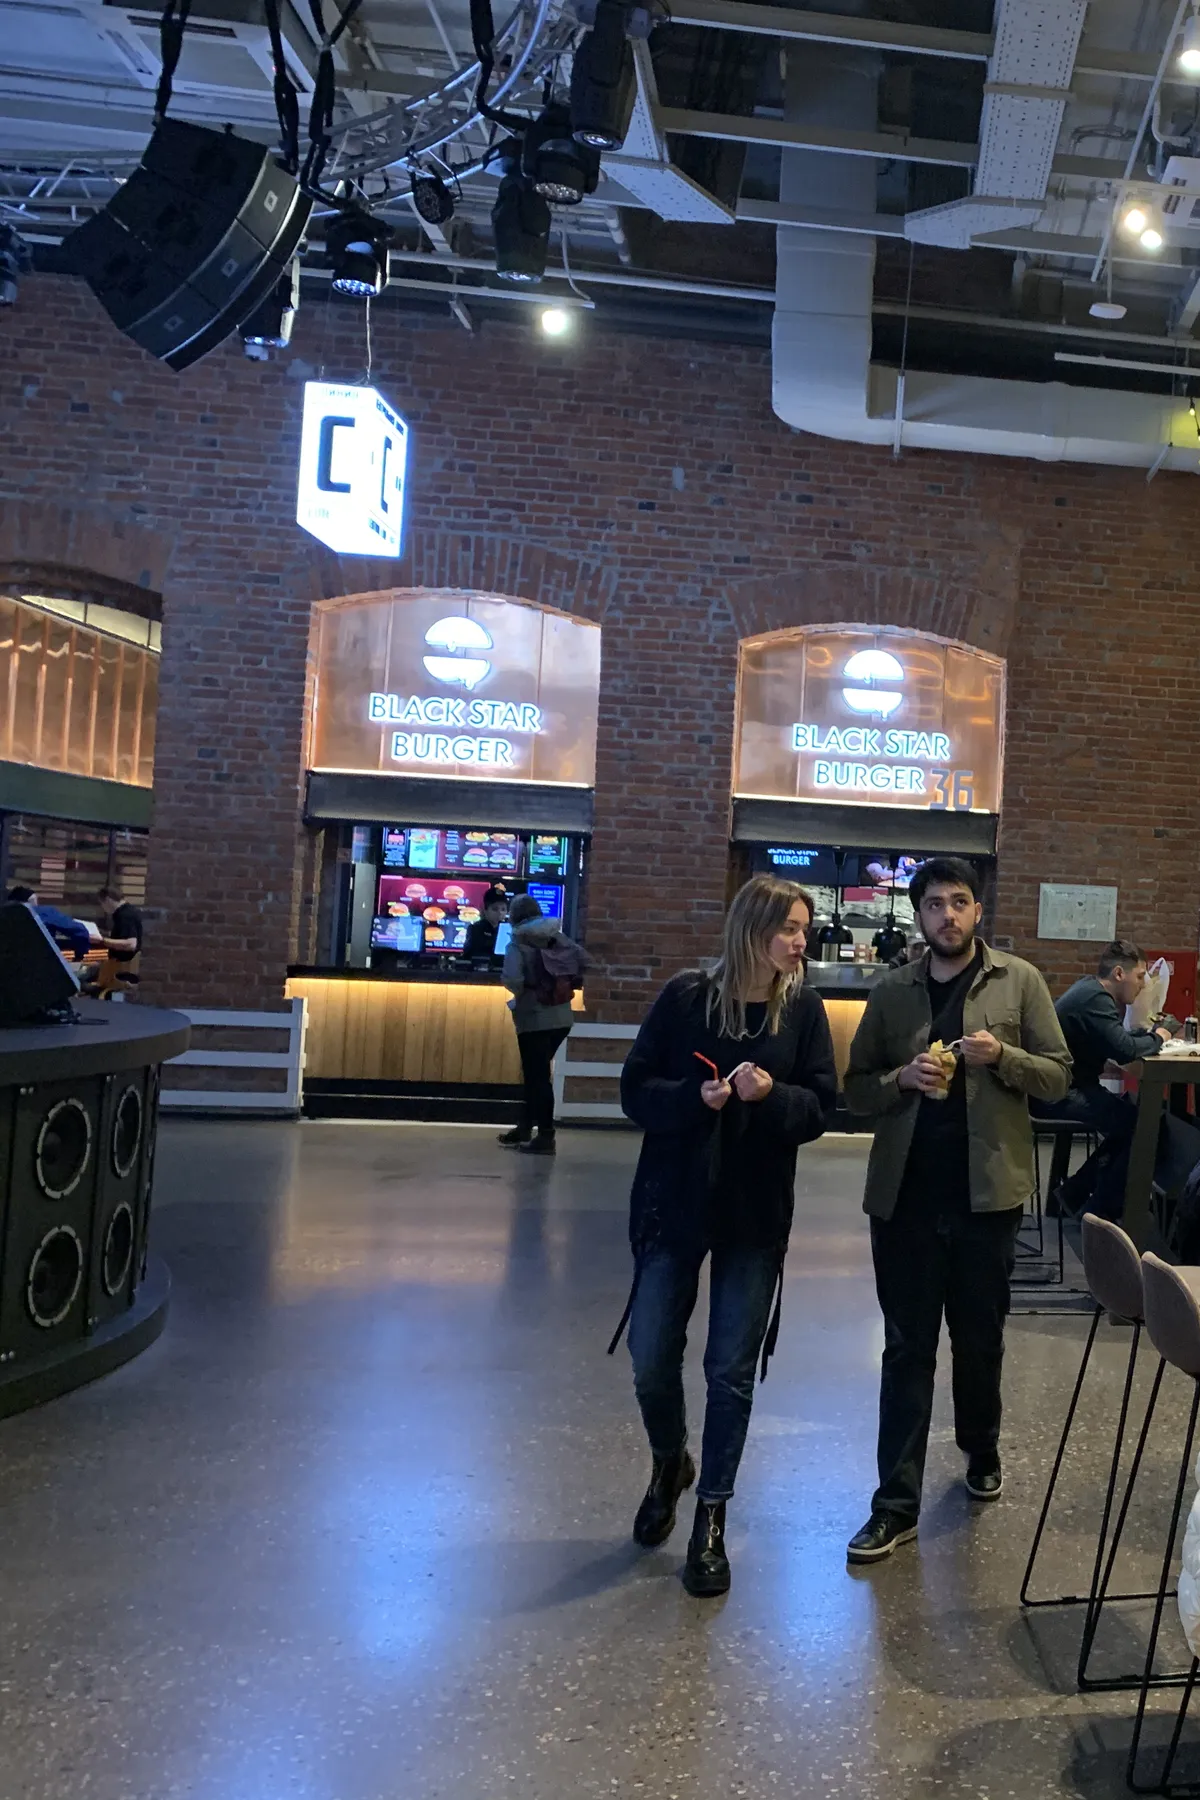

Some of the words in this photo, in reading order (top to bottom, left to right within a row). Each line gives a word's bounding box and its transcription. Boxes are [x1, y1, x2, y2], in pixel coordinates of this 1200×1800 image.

[369, 693, 466, 727] BLACK
[468, 699, 541, 732] STAR
[391, 732, 514, 766] BURGER
[793, 723, 881, 756] BLACK
[883, 729, 951, 760] STAR
[814, 760, 927, 793] BURGER
[929, 768, 975, 811] 36
[772, 854, 811, 866] BURGER
